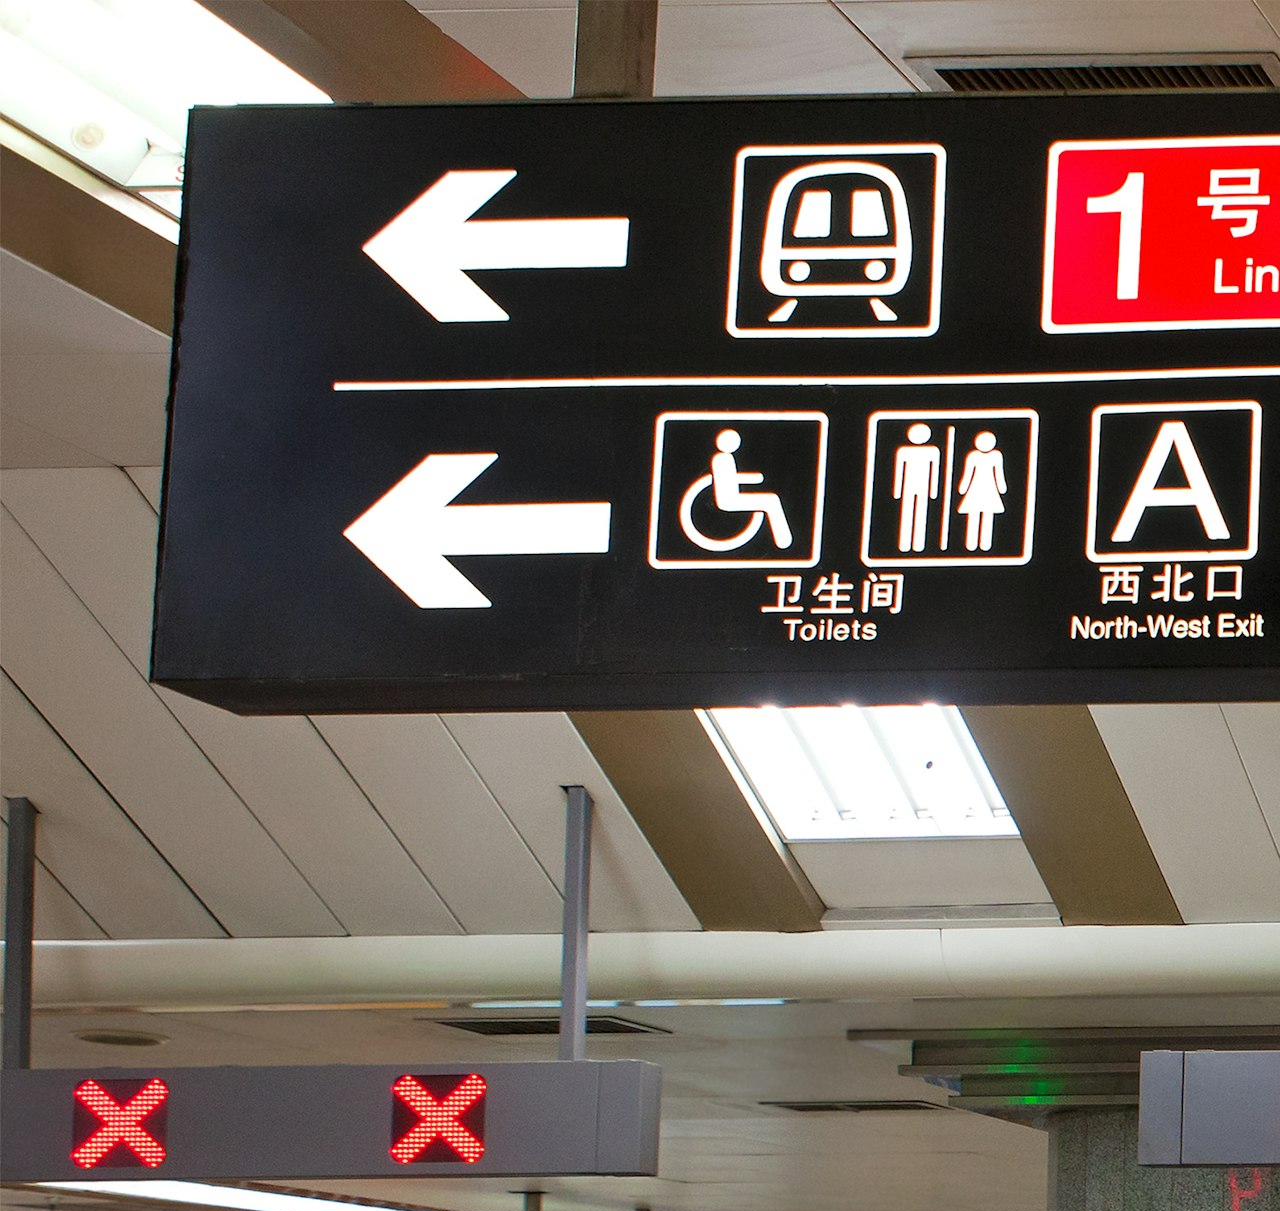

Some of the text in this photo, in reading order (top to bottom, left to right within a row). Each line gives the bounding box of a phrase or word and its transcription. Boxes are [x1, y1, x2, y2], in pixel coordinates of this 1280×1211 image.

[1087, 172, 1144, 300] 1
[1111, 422, 1232, 542] A
[761, 573, 904, 615] 卫生间
[1099, 565, 1244, 606] 西北口
[783, 618, 878, 642] Toilets
[1070, 612, 1265, 641] North-West Exit
